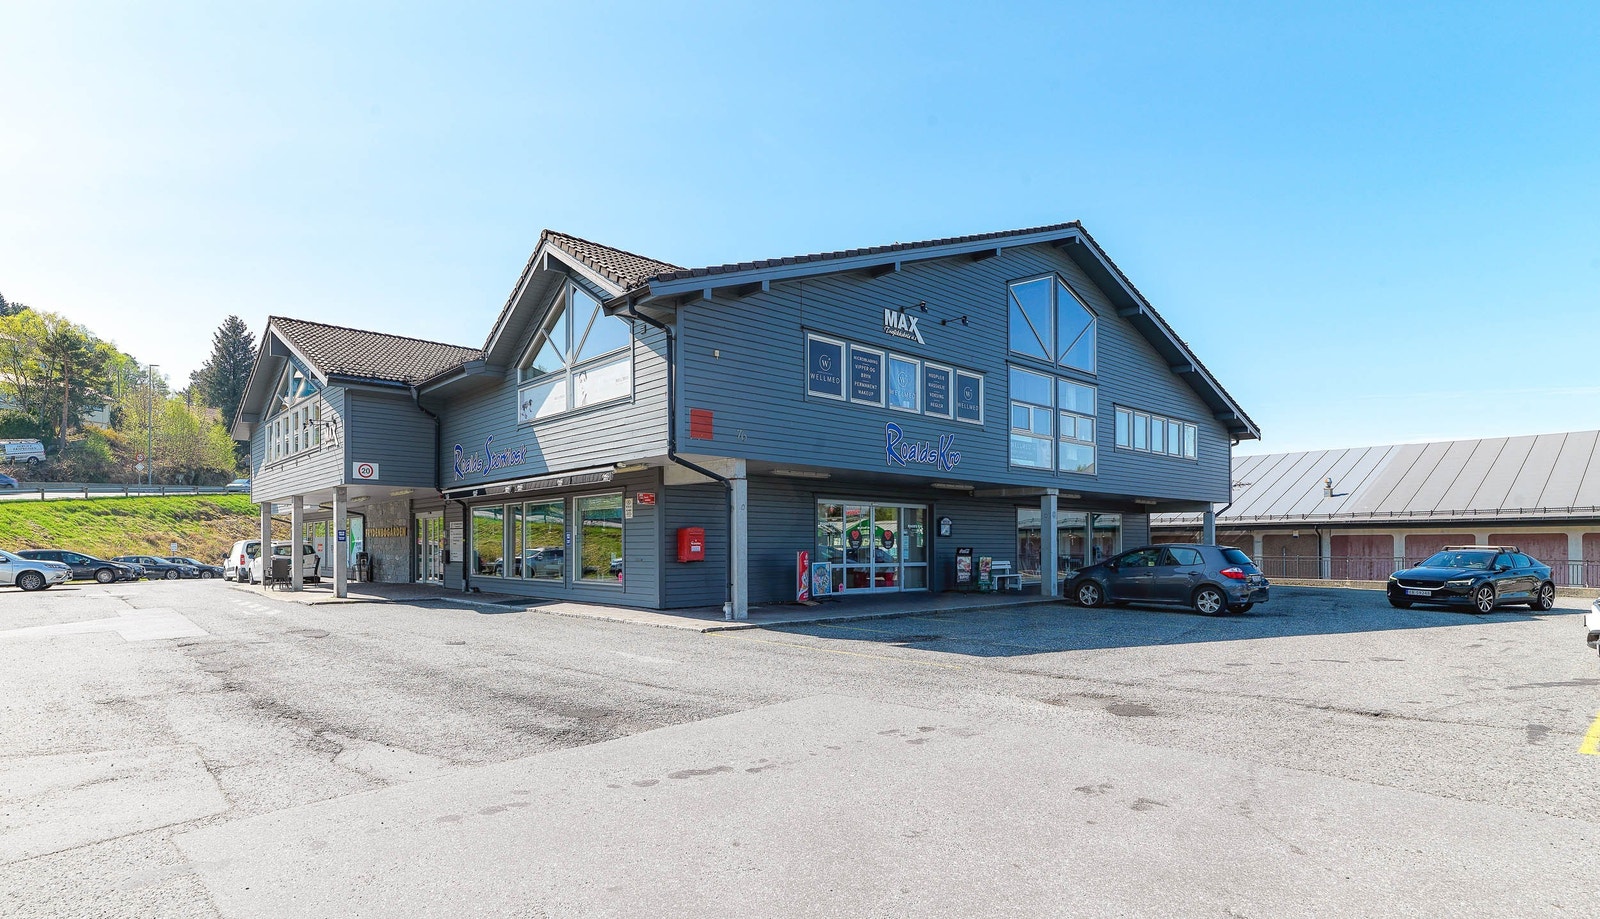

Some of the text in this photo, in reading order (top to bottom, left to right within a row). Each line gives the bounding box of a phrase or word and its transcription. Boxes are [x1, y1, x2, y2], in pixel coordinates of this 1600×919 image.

[884, 308, 925, 345] MAX
[809, 372, 841, 384] WELLMED
[361, 467, 371, 475] 20
[454, 443, 484, 481] Roalds
